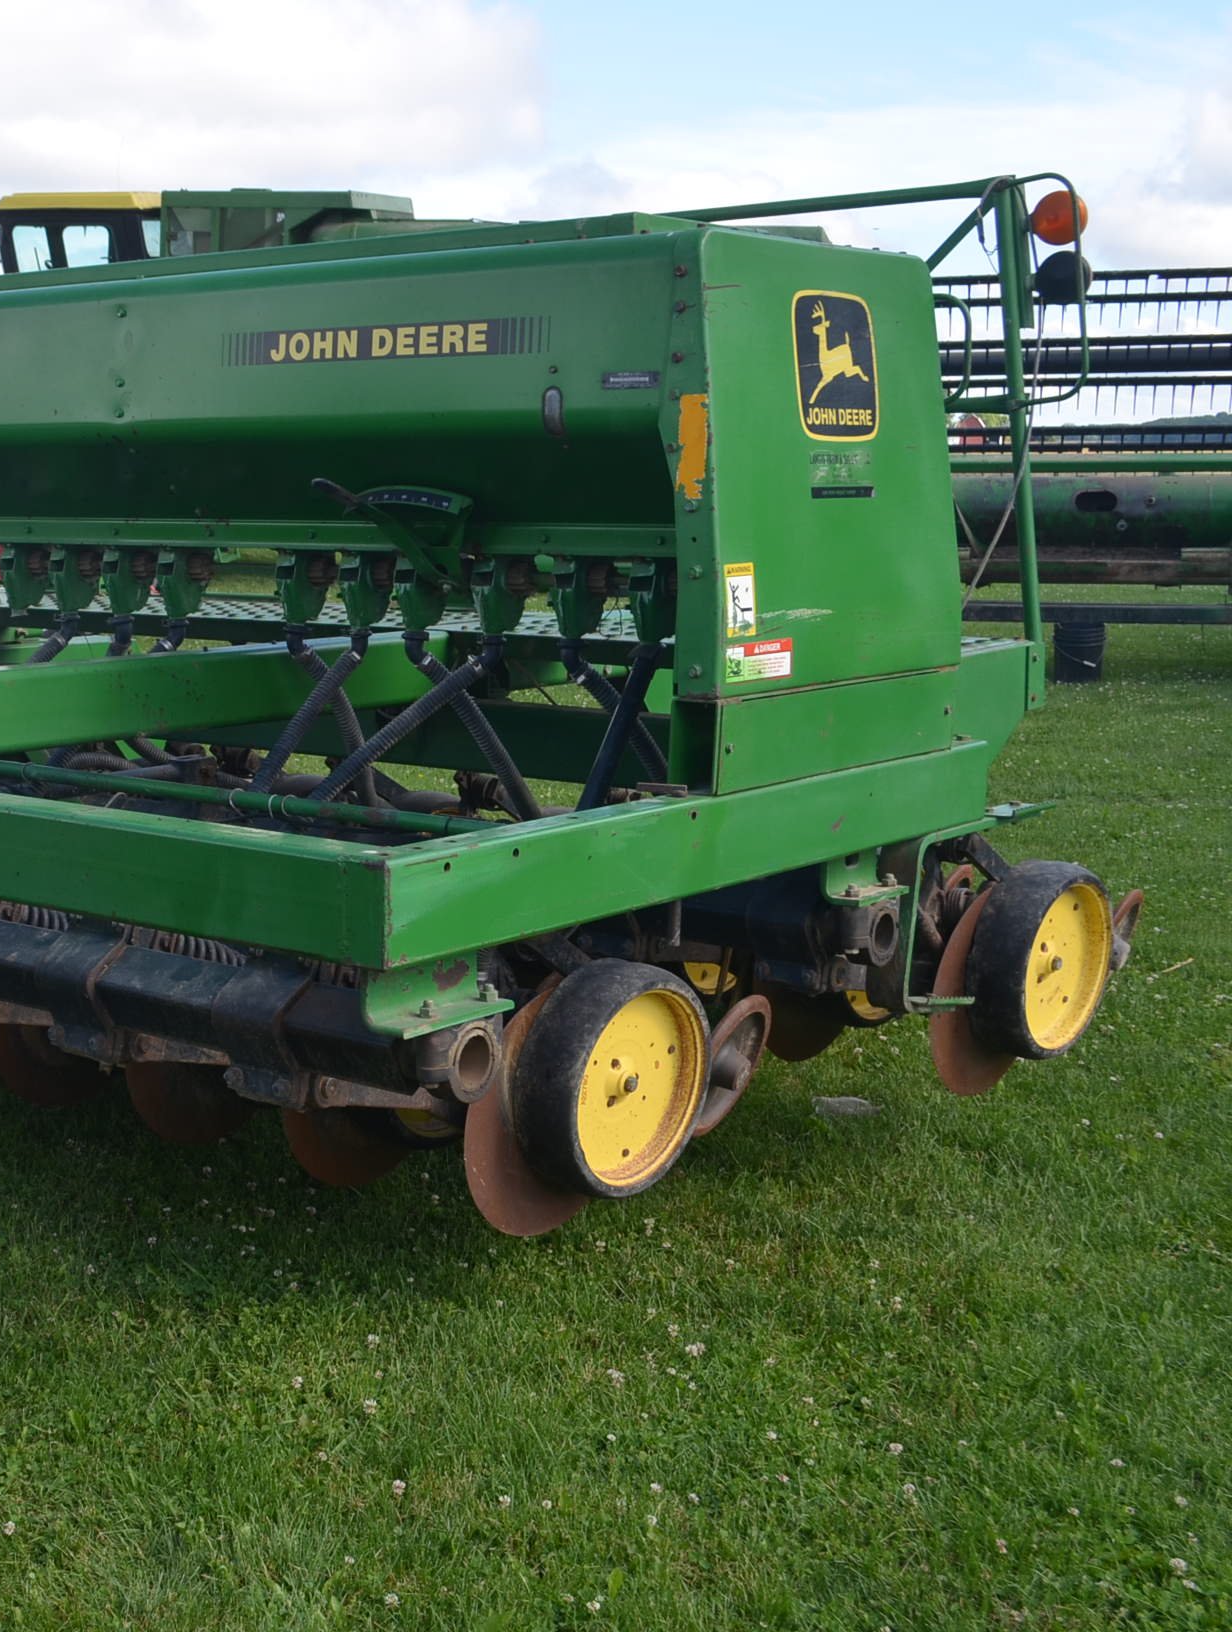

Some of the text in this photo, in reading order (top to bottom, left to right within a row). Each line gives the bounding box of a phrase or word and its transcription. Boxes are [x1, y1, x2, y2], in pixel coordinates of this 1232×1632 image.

[270, 323, 488, 361] JOHN DEERE
[807, 407, 873, 426] JOHN DEERE
